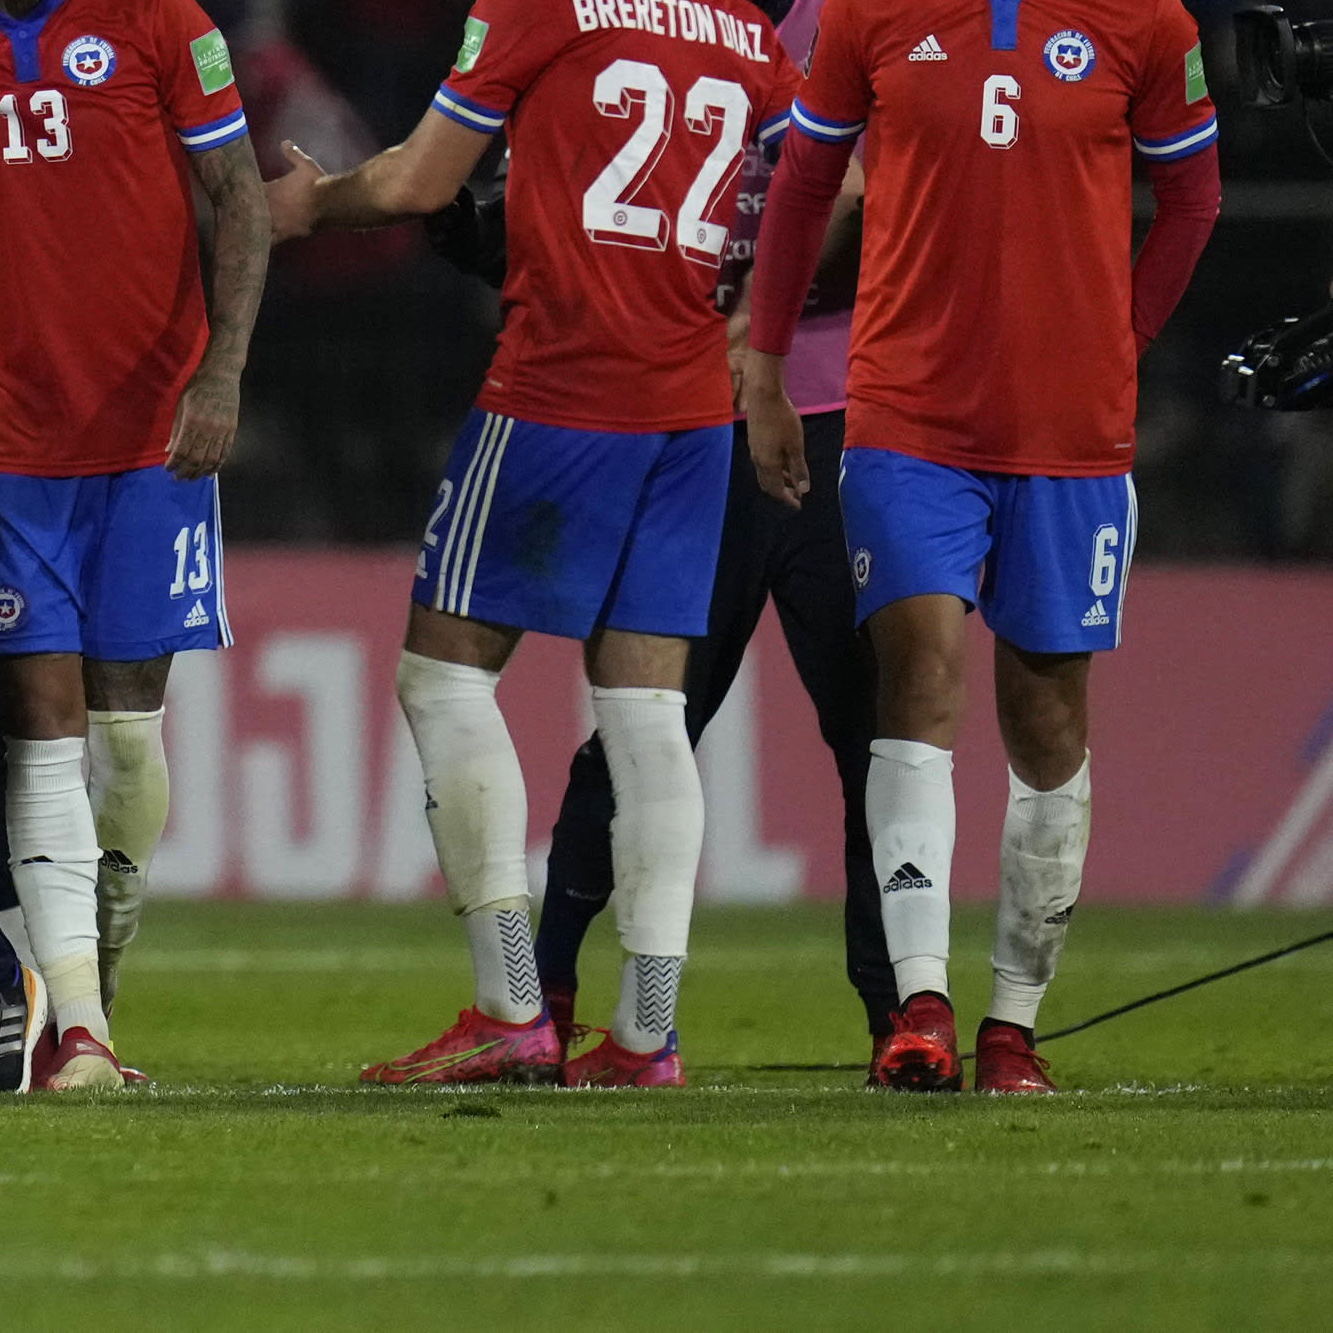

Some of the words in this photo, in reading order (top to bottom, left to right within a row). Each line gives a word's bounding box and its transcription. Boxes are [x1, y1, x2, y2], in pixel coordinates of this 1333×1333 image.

[714, 8, 770, 63] DIAZ
[908, 51, 948, 62] adidas
[980, 74, 1021, 150] 6
[583, 58, 753, 270] 22
[169, 520, 213, 601] 13
[1089, 523, 1119, 597] 6
[184, 615, 210, 628] adidas
[1081, 615, 1110, 627] adidas
[883, 877, 933, 894] adidas
